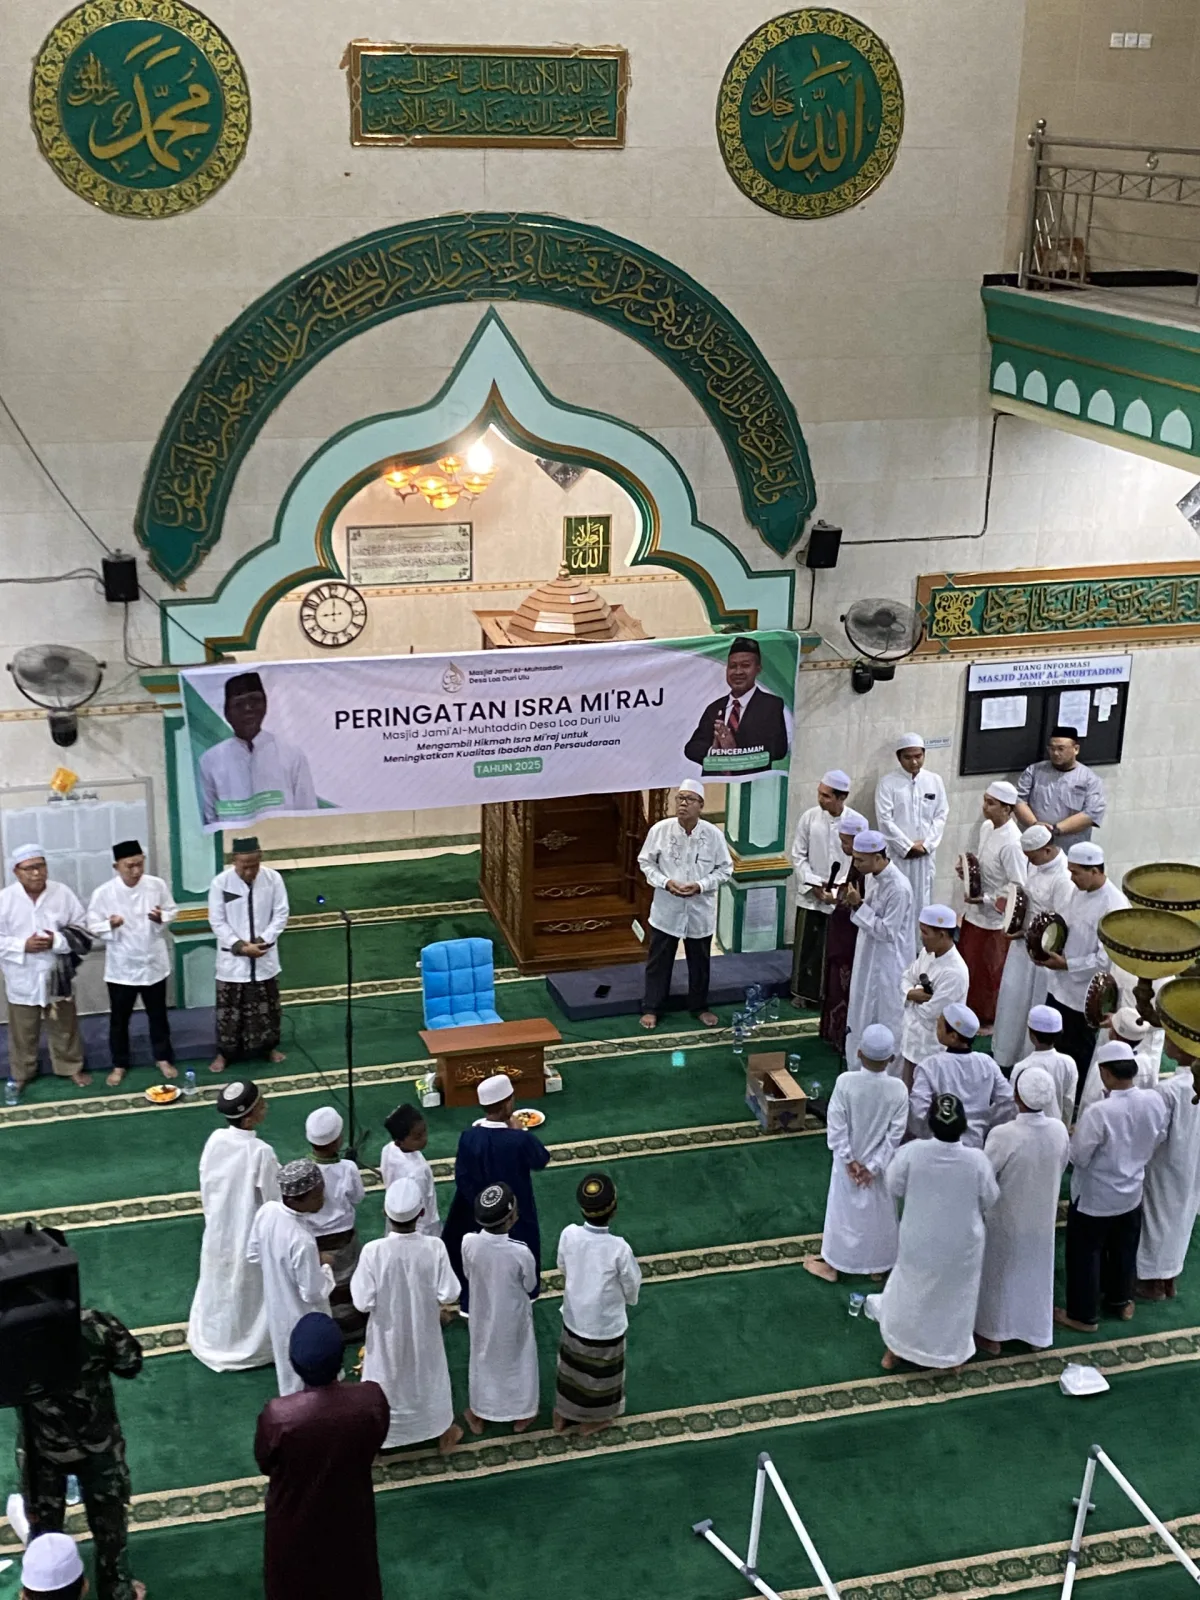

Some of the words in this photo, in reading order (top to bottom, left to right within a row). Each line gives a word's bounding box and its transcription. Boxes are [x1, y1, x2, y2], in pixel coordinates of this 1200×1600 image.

[469, 669, 493, 677] Masjid
[1013, 663, 1041, 672] RUANG
[1043, 660, 1091, 670] INFORMASI
[977, 673, 1015, 684] MASJID
[335, 700, 506, 730] PERINGATAN
[515, 695, 572, 717] ISRA
[580, 687, 664, 713] MI'RAJ
[382, 729, 419, 741] Masjid
[452, 721, 527, 736] Al-Muhtaddin
[530, 720, 556, 730] Desa
[559, 718, 578, 727] Loa
[580, 715, 601, 726] Duri
[604, 714, 620, 723] Ulu
[416, 738, 472, 752] Mengambil
[473, 736, 511, 748] Hikmah
[513, 734, 532, 742] Isra
[561, 729, 589, 740] untuk
[383, 750, 454, 764] Meningkatkan
[456, 747, 496, 758] Kualitas
[497, 744, 532, 755] Ibadah
[533, 743, 552, 752] dan
[554, 738, 621, 750] Persaudaraan
[711, 745, 764, 756] PENCERAMAH
[476, 763, 513, 775] TAHUN
[514, 760, 541, 772] 2025
